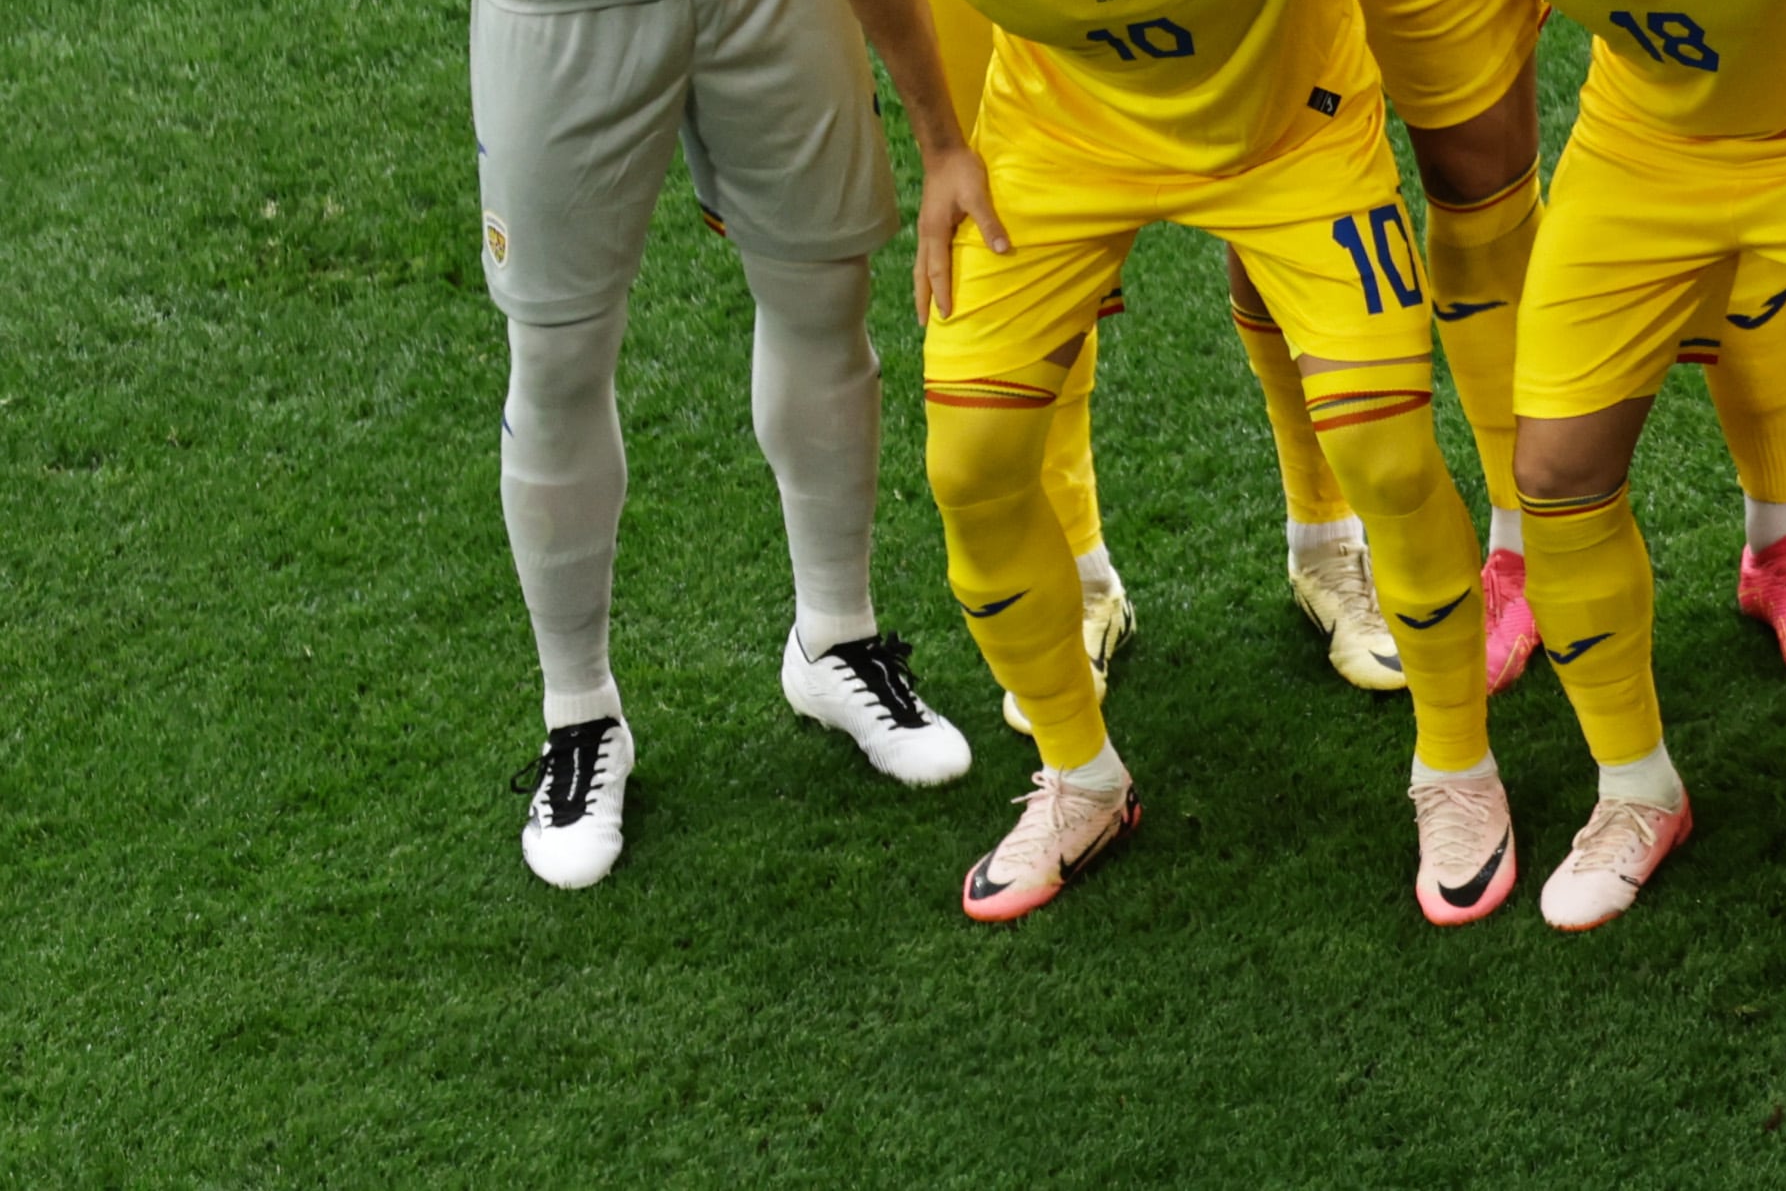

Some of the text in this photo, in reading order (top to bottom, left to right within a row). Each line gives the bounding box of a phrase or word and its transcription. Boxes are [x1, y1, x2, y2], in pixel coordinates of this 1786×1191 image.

[1087, 18, 1195, 61] 10
[1609, 10, 1720, 73] 18
[1333, 203, 1424, 315] 10
